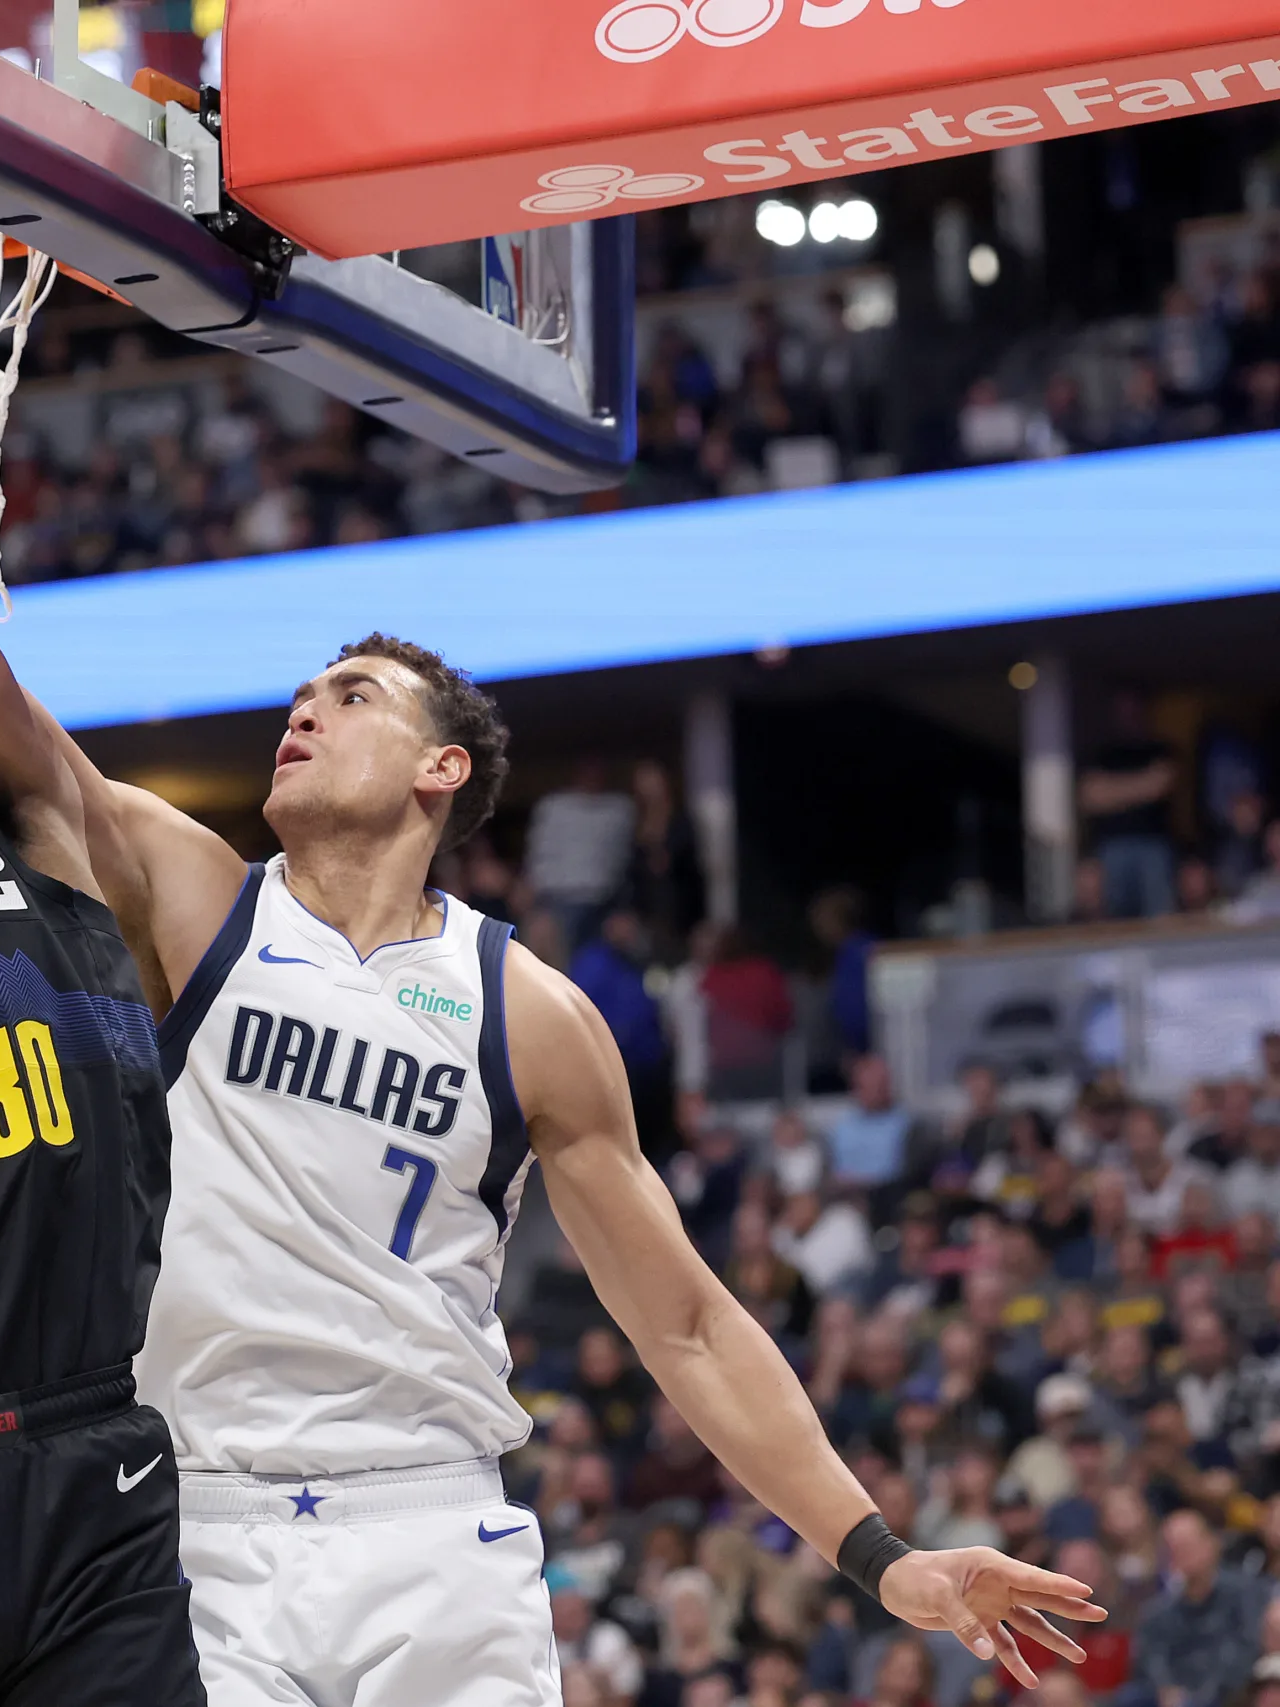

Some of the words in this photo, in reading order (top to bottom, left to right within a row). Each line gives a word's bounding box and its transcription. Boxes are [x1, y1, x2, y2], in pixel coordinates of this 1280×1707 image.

[703, 105, 1044, 182] State
[397, 983, 473, 1022] chime
[223, 1003, 469, 1139] DALLAS
[380, 1142, 439, 1263] 7
